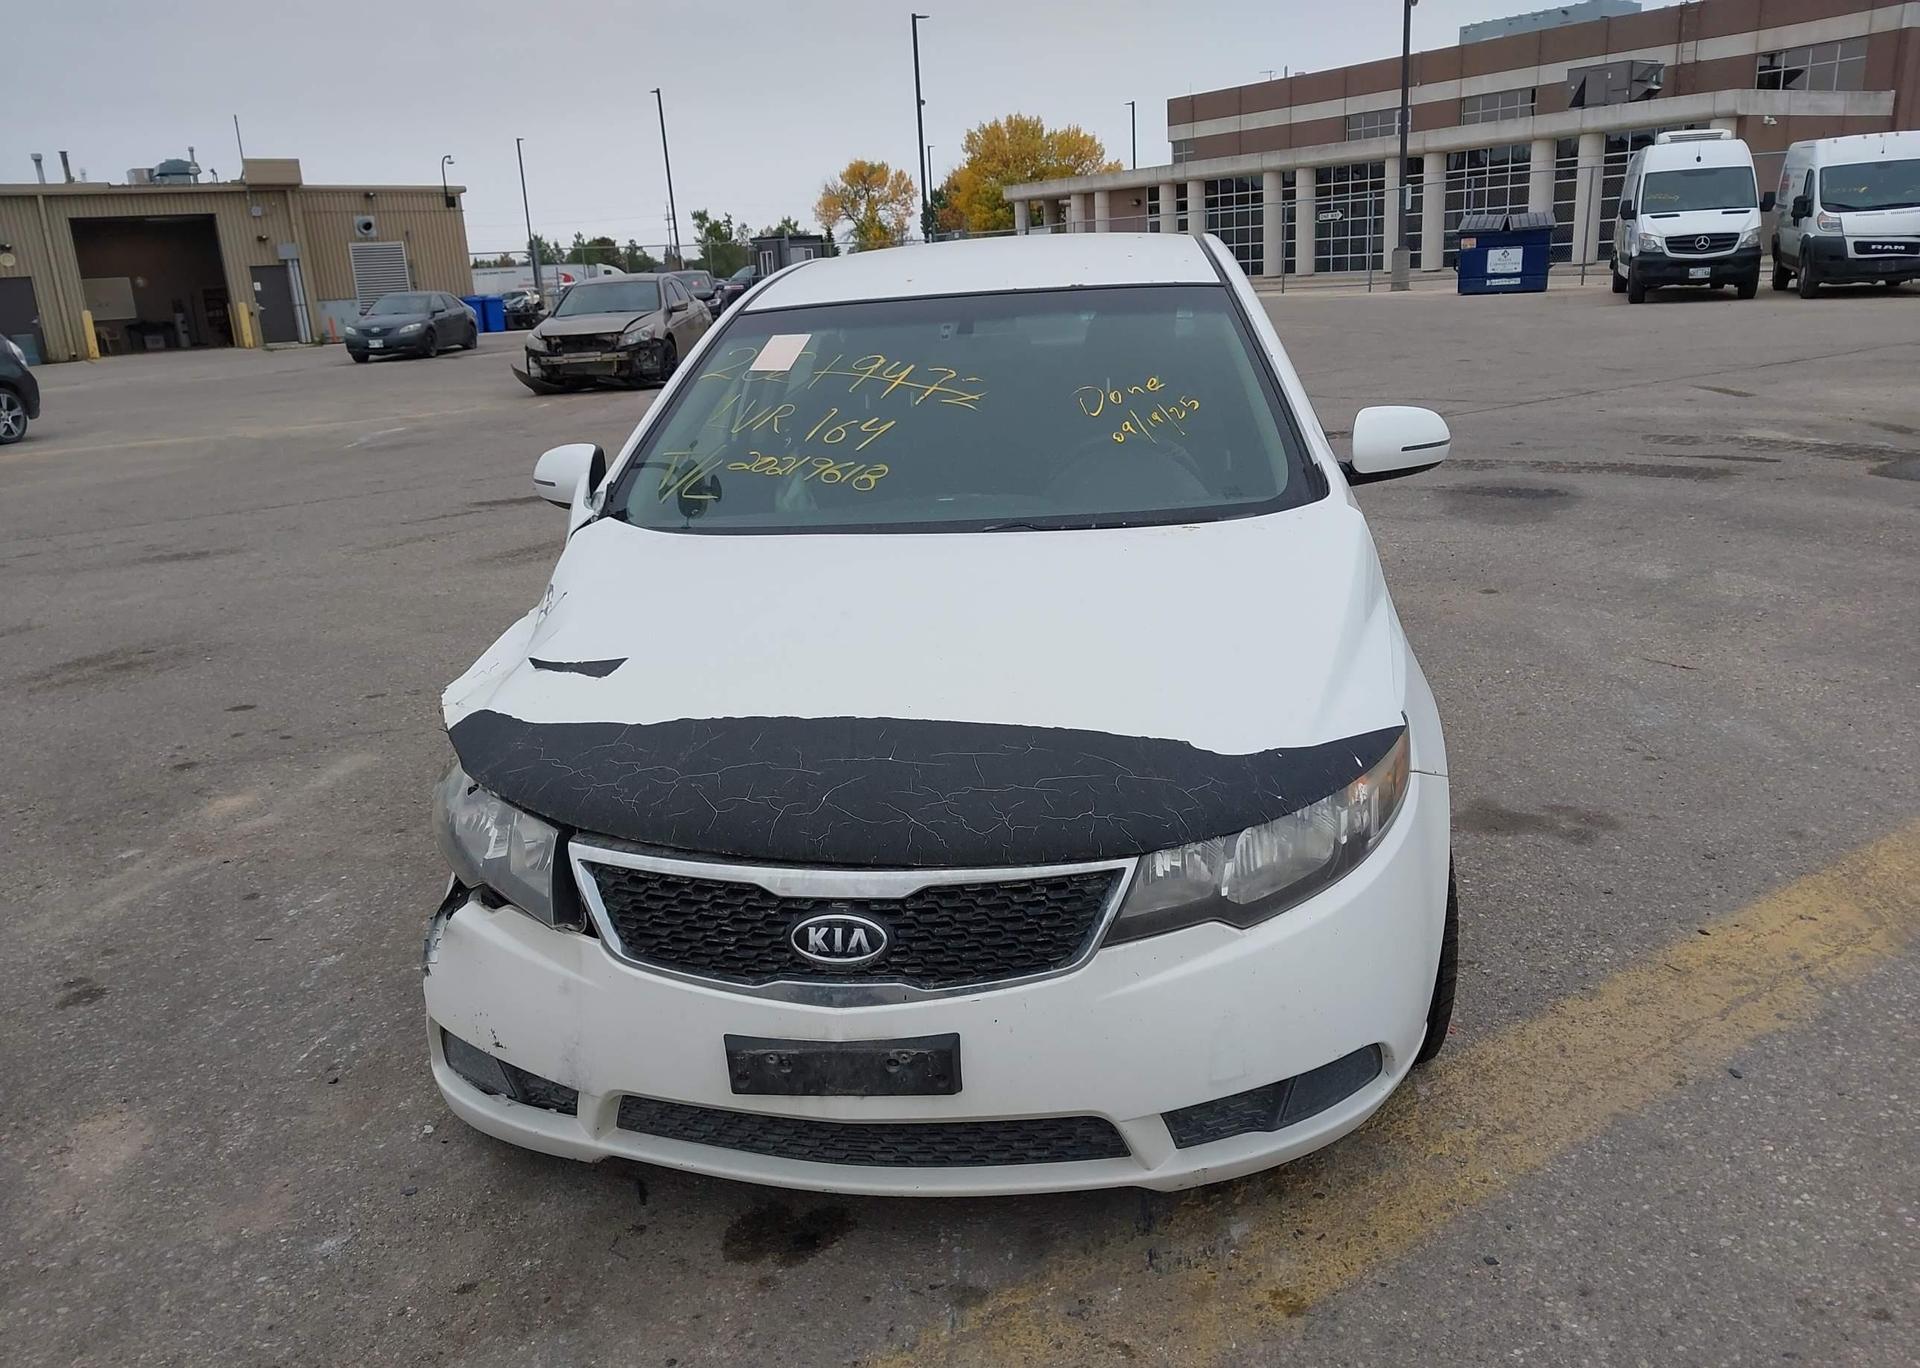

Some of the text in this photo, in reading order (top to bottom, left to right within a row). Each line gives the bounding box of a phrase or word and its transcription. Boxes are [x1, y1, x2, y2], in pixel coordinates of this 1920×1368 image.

[1071, 376, 1167, 417] Done
[804, 407, 897, 451] 164
[807, 926, 872, 953] KIA
